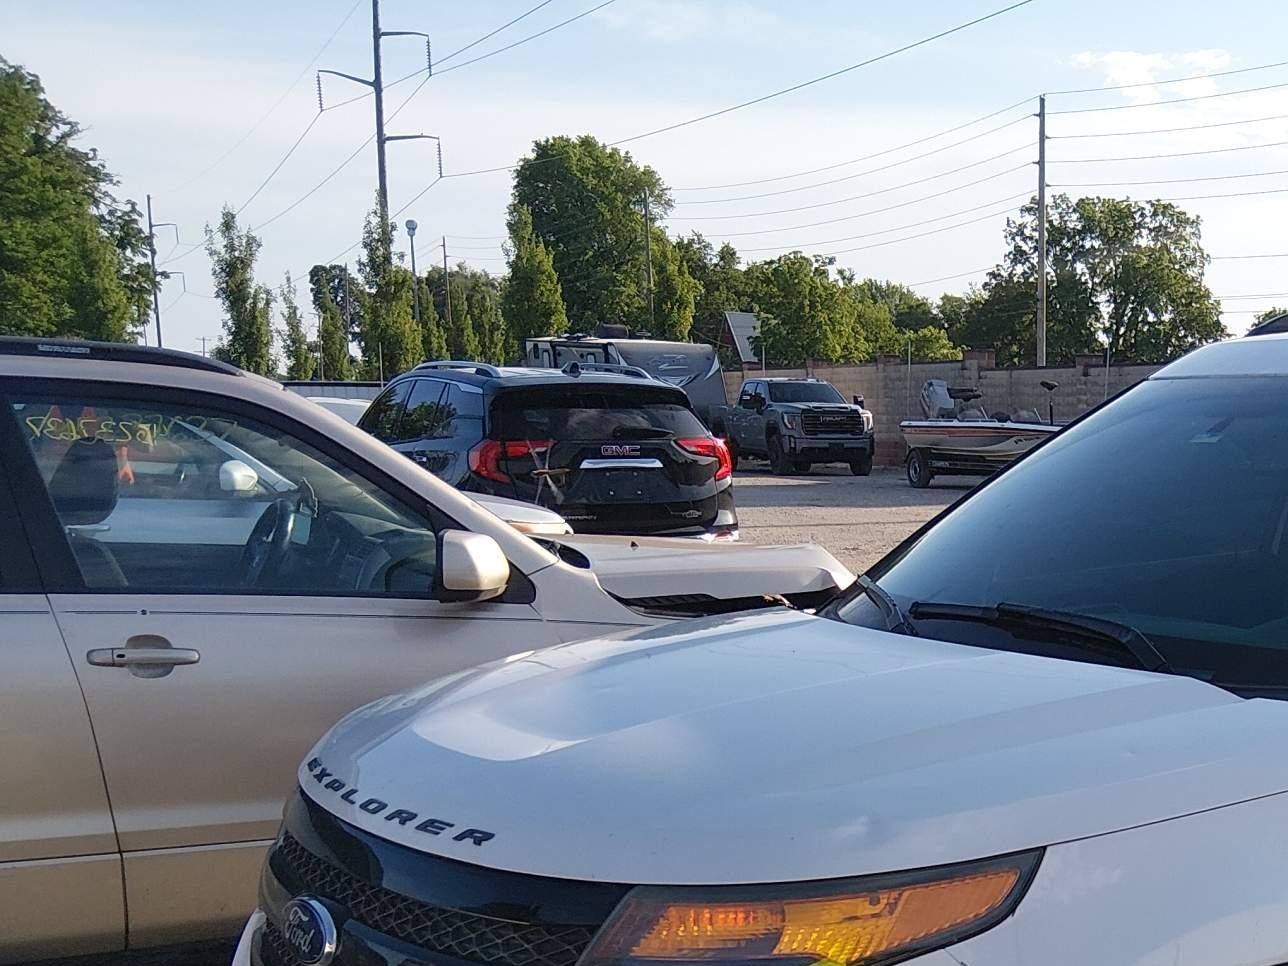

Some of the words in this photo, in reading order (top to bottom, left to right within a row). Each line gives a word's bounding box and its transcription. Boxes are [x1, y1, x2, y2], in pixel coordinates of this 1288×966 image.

[601, 445, 641, 456] GMC
[306, 756, 497, 848] EXPLORER
[284, 906, 315, 953] Ford
